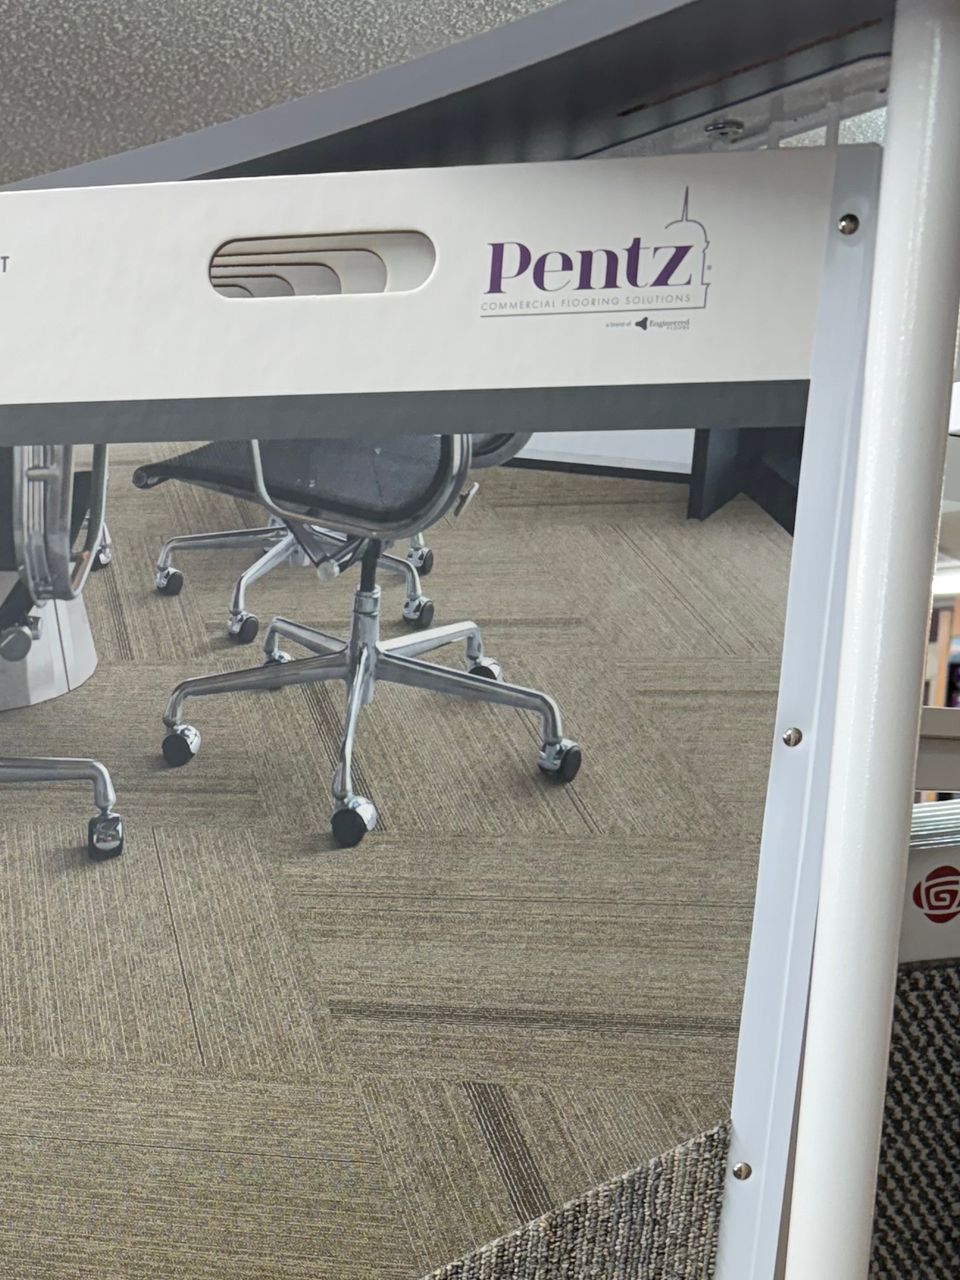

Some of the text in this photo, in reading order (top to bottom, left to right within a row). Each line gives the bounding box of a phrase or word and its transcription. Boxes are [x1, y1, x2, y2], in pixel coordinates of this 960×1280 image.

[484, 237, 695, 295] Pentz
[480, 293, 691, 311] COMMERCIAL FLOORING SOLUTIONS
